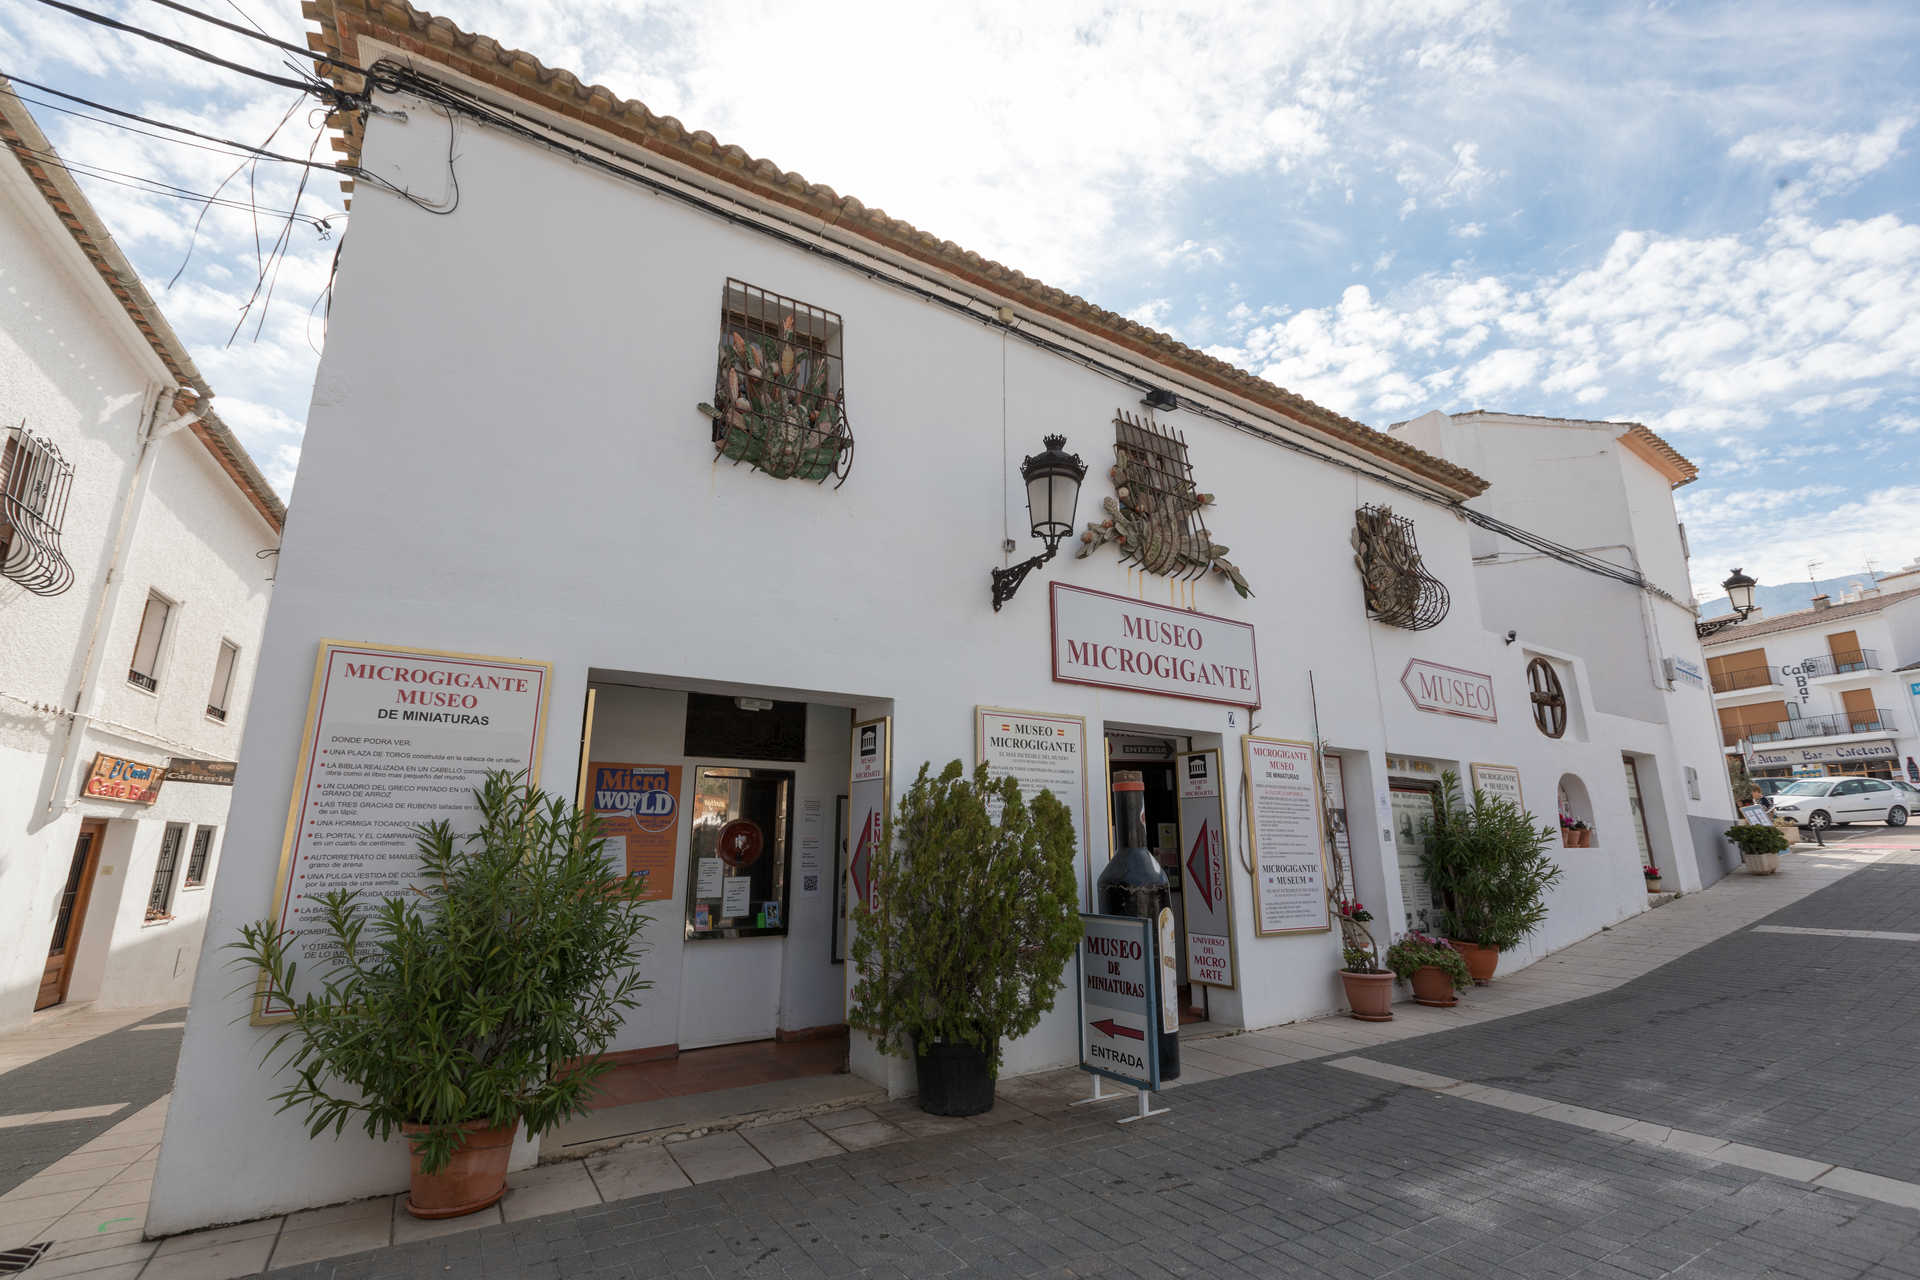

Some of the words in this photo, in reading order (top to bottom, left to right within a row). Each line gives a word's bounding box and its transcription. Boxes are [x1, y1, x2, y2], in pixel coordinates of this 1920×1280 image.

[1122, 614, 1203, 650] MUSEO
[1067, 639, 1251, 691] MICROGIGANTE
[344, 662, 528, 692] MICROGIGANTE
[1418, 671, 1490, 711] MUSEO
[1796, 676, 1809, 704] Bar
[396, 689, 478, 709] MUSEO
[378, 708, 397, 720] DE
[402, 710, 489, 726] MINIATURAS
[1015, 723, 1053, 737] MUSEO
[332, 736, 361, 744] DONDE
[363, 737, 392, 745] PODRA
[990, 736, 1076, 753] MICROGIGANTE
[385, 751, 411, 759] TOROS
[1253, 746, 1308, 761] MICROGIGANTE
[1802, 750, 1822, 761] Bar
[109, 760, 125, 779] El
[363, 764, 404, 772] REALIZADA
[430, 766, 462, 774] CABELLO
[1269, 760, 1295, 771] MUSEO
[168, 771, 231, 783] Cafeteria
[601, 769, 666, 791] Micro
[597, 790, 673, 814] WORLD
[1211, 828, 1223, 902] MUSEO
[1262, 864, 1319, 873] MICROGIGANTIC
[1276, 876, 1306, 885] MUSEUM
[1087, 935, 1142, 961] MUSEO
[1192, 936, 1225, 946] UNIVERSO
[304, 951, 316, 959] DE
[1203, 946, 1214, 955] DEL
[1107, 960, 1120, 976] DE
[1194, 955, 1226, 969] MICRO
[1199, 968, 1223, 982] ARTE
[1087, 975, 1145, 999] MINIATURAS
[1091, 1044, 1144, 1070] ENTRADA
